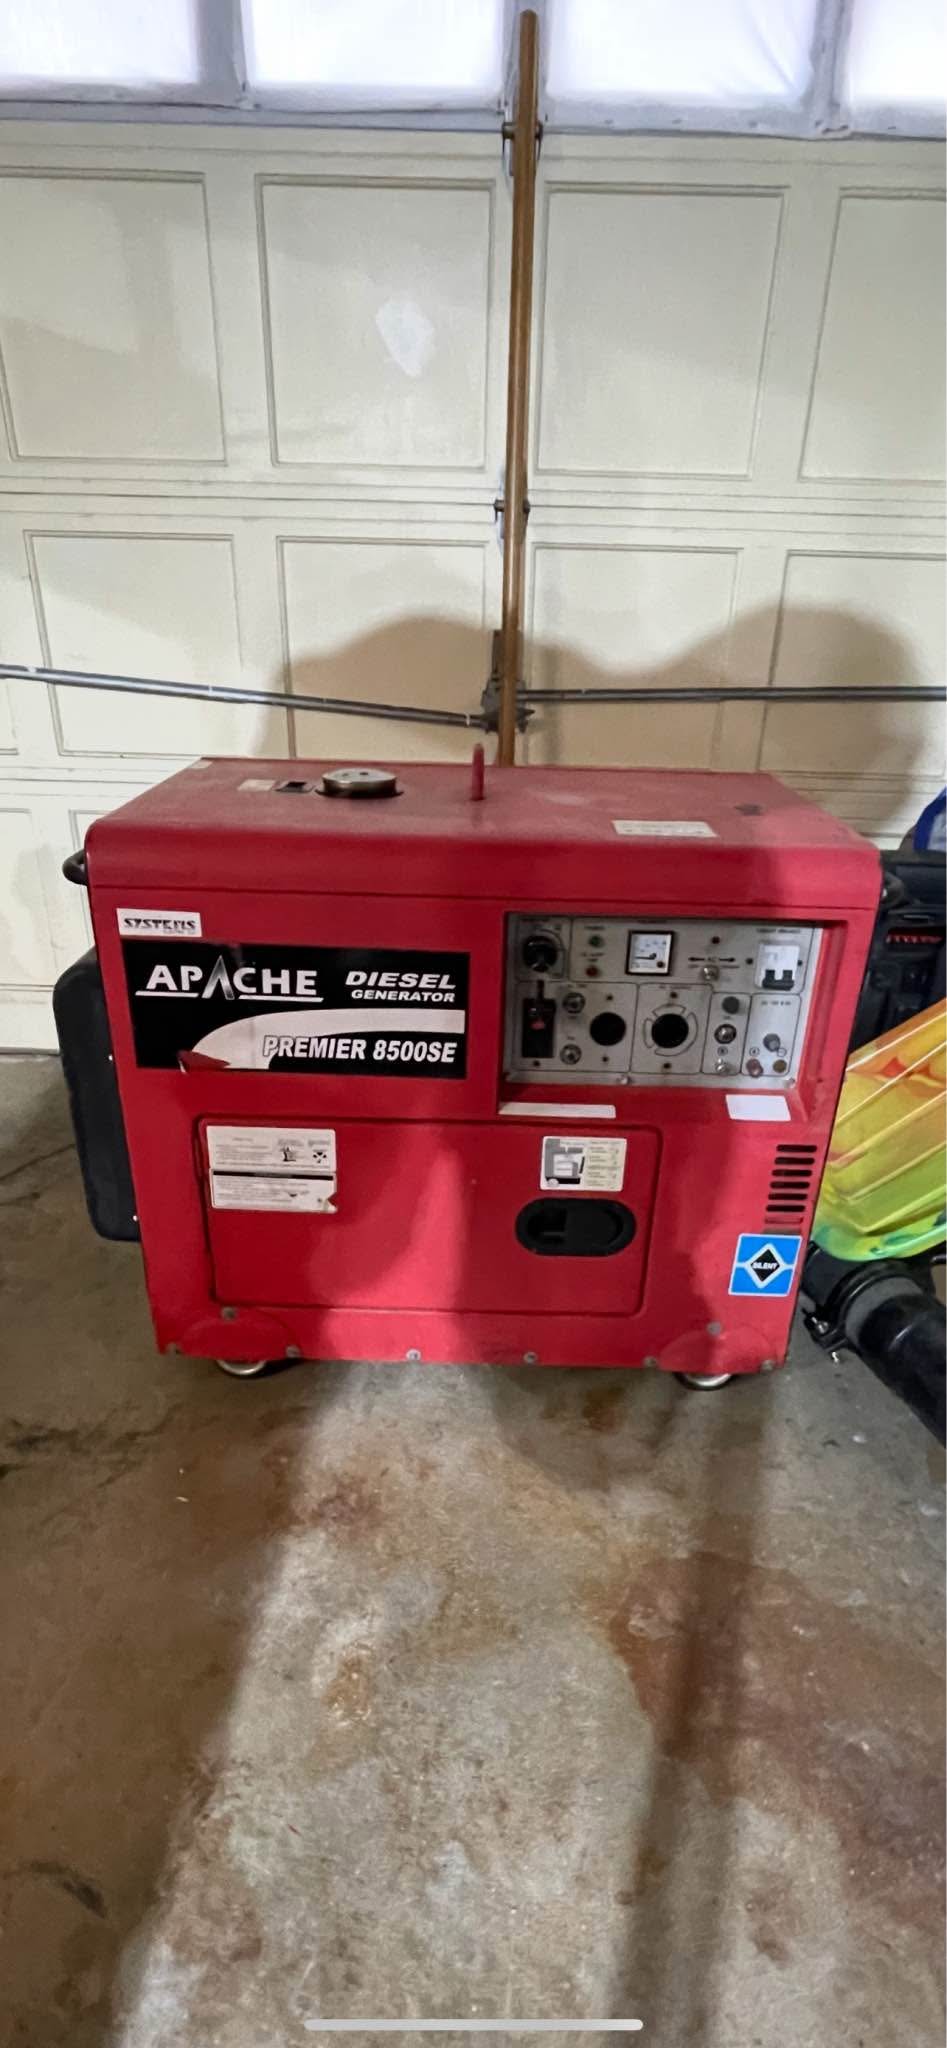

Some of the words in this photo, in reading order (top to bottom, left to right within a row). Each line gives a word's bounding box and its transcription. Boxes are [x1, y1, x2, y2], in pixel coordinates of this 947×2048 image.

[124, 918, 196, 930] SYSTEMS
[146, 955, 317, 999] APACHE
[345, 970, 456, 989] DIESEL
[351, 990, 455, 1003] GENERATOR
[263, 1035, 366, 1060] PREMIER
[372, 1040, 457, 1063] 8500SE
[752, 1262, 778, 1270] SILENT
